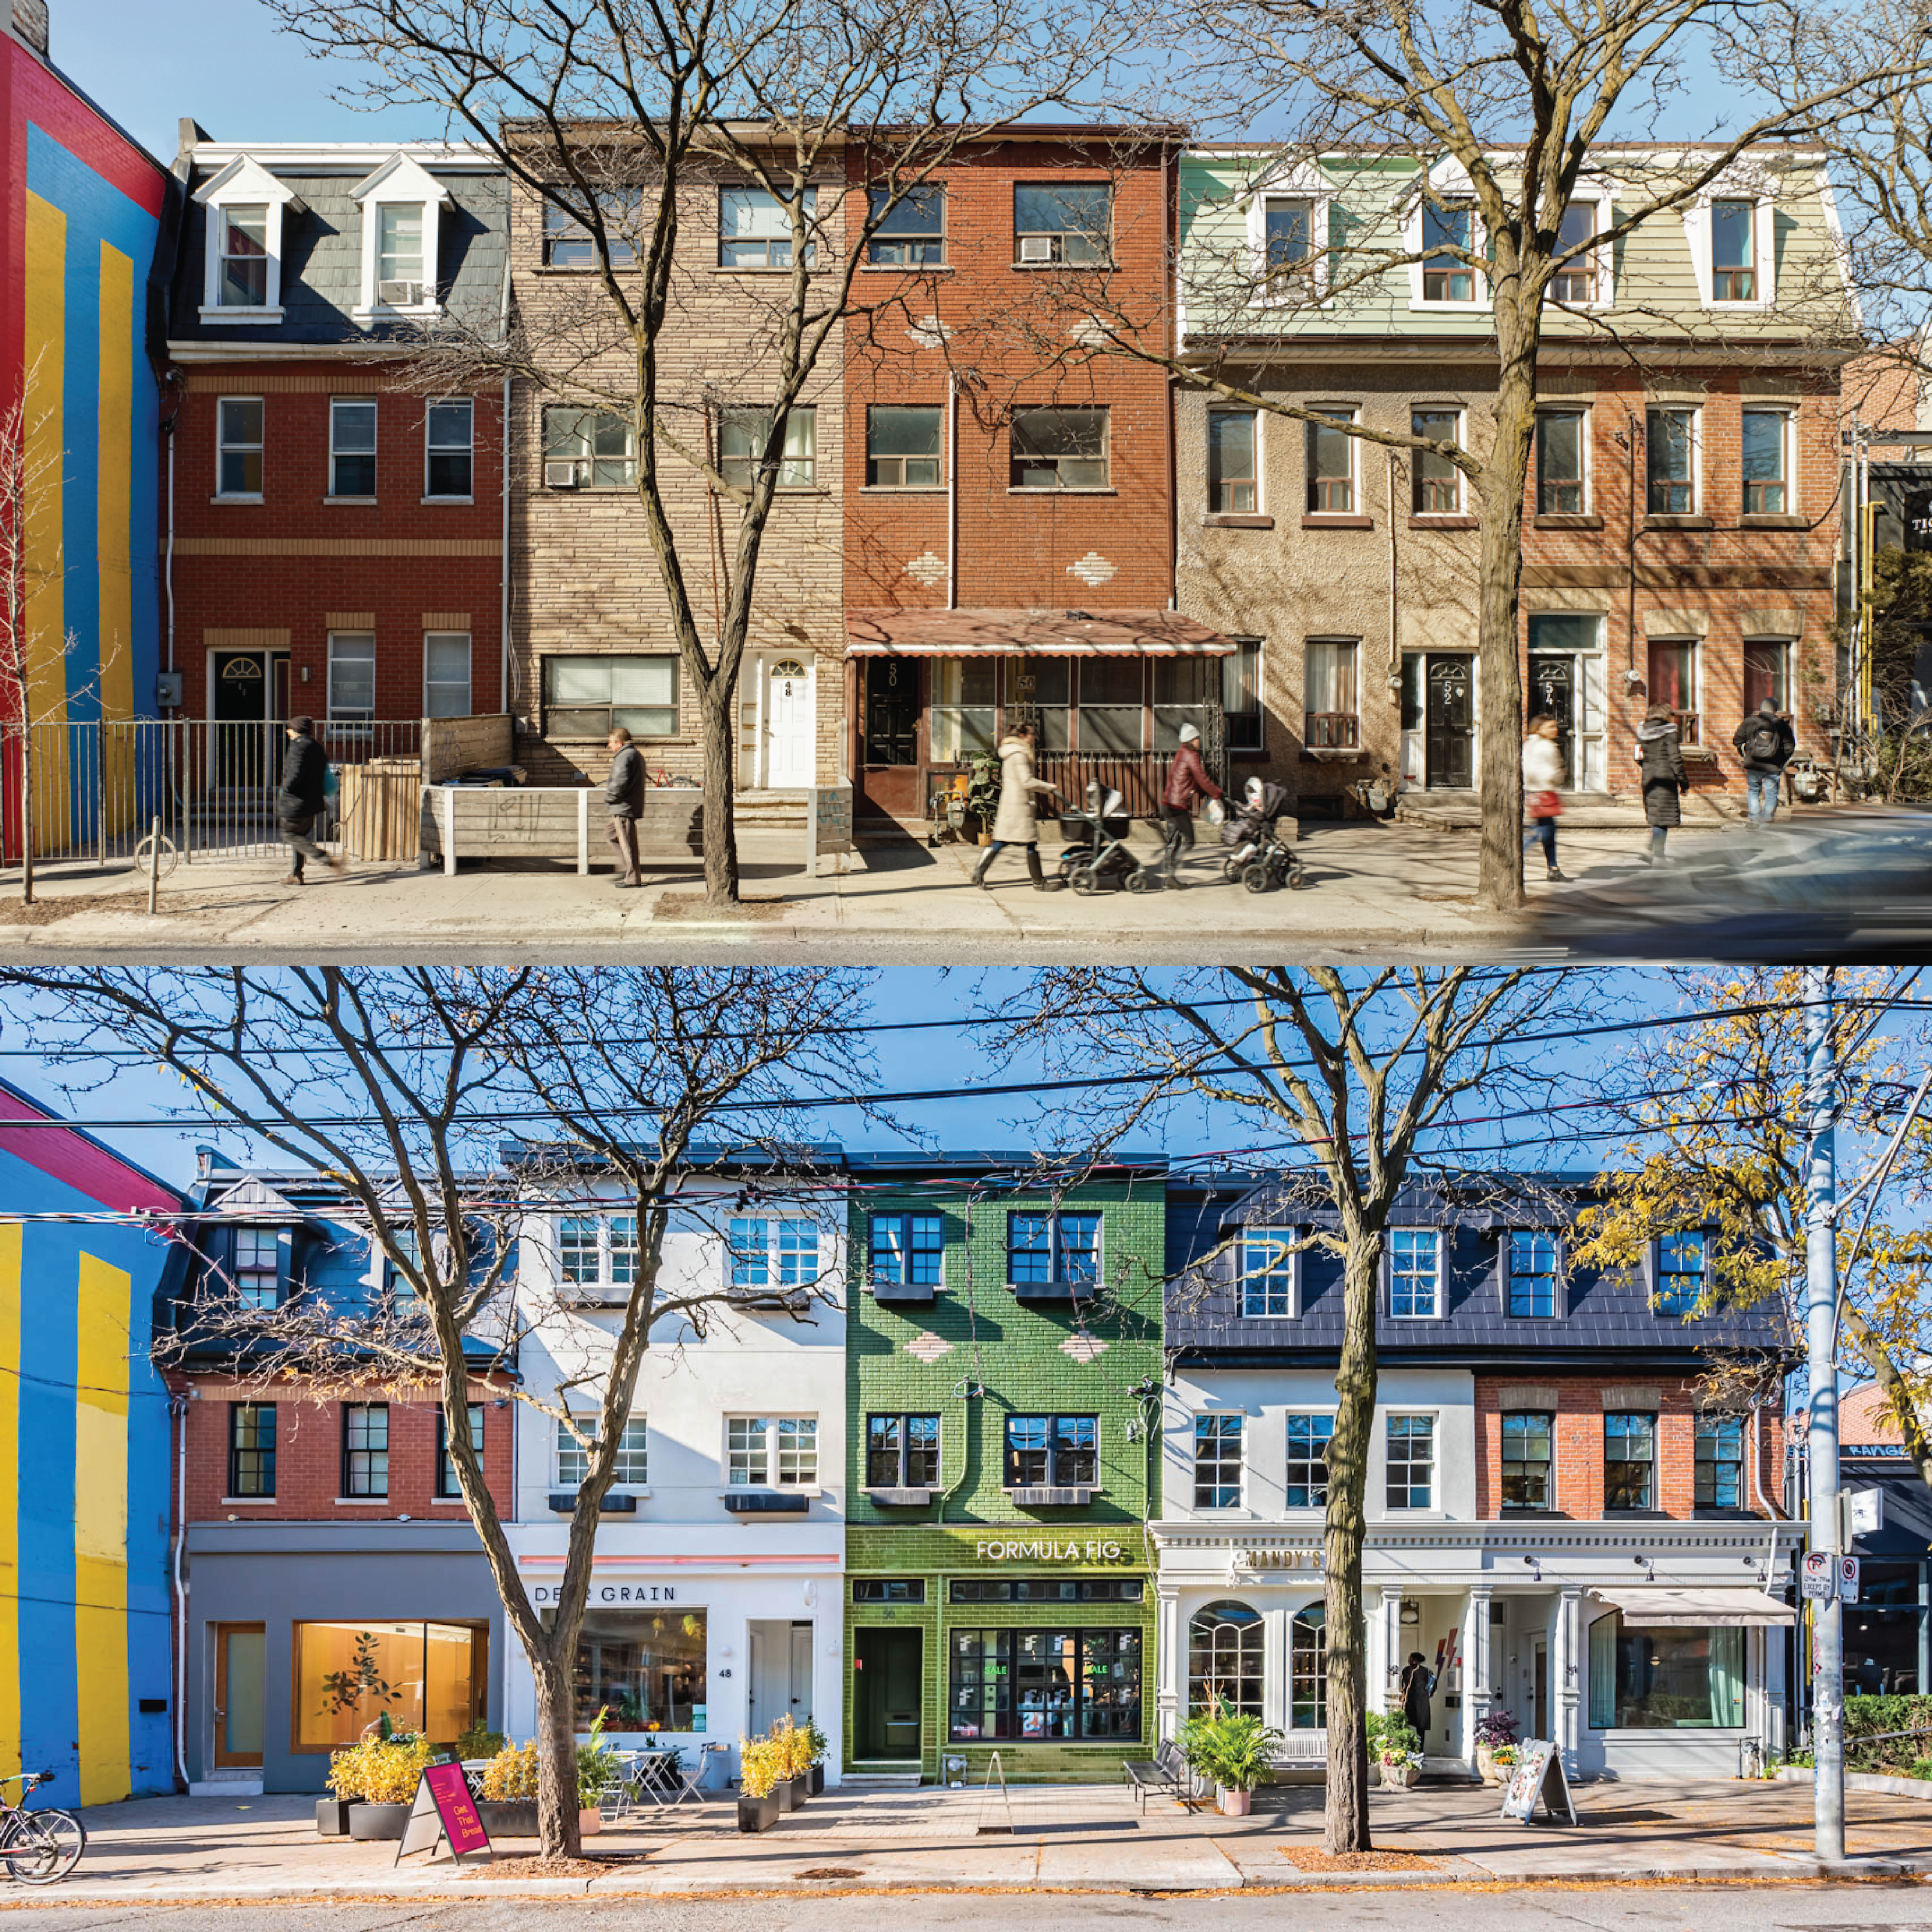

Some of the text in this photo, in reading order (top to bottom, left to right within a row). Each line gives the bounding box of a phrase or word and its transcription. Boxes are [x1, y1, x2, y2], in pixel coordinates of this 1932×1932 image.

[889, 663, 896, 687] 50
[976, 1540, 1121, 1559] FORMULA FIG
[1245, 1550, 1321, 1568] MANDY'S
[601, 1587, 674, 1601] GRAIN
[719, 1669, 732, 1678] 48
[984, 1666, 1007, 1675] SALE
[453, 1805, 469, 1815] Get
[457, 1815, 475, 1826] That
[461, 1824, 483, 1839] Bread
